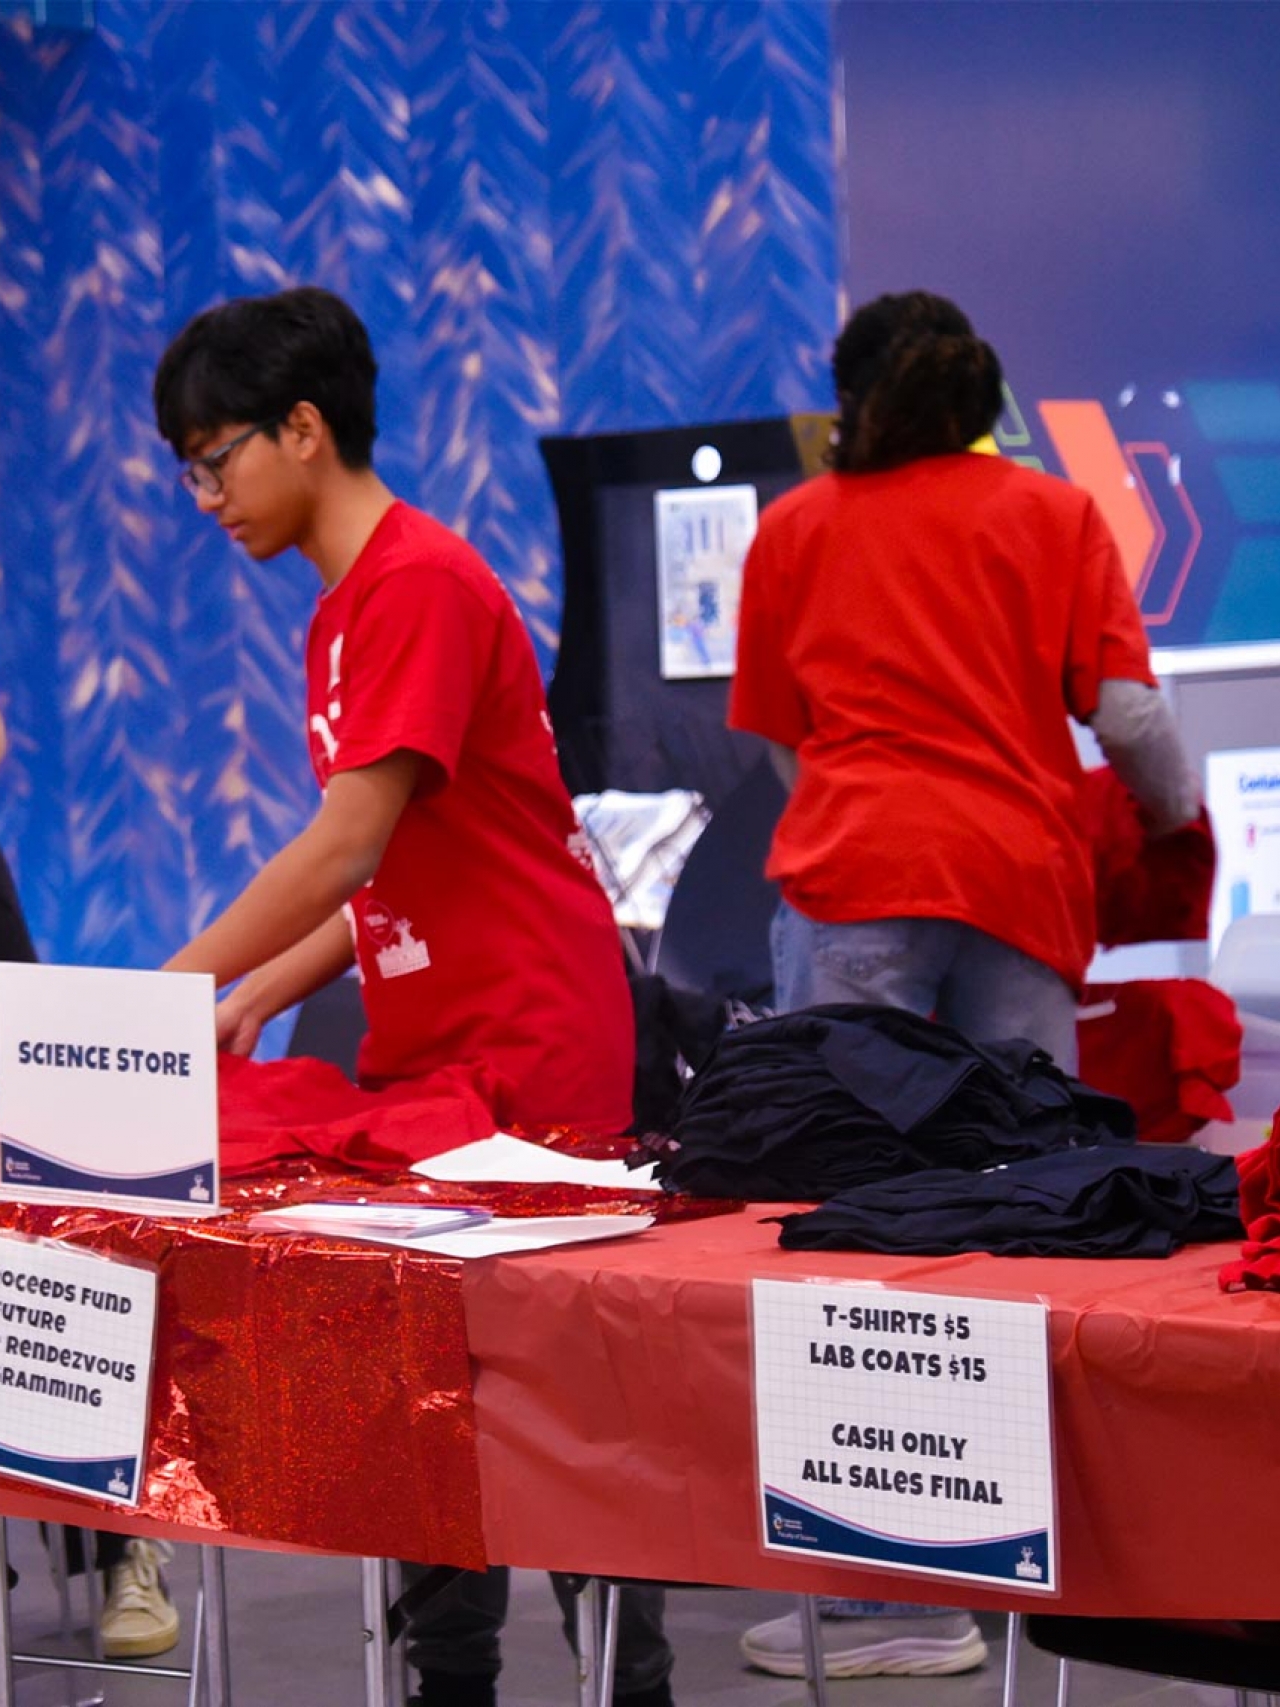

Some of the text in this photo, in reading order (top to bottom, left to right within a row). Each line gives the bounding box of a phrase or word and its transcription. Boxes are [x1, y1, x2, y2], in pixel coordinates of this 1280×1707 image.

[18, 1040, 191, 1077] SCIENCE STORE
[80, 1287, 132, 1315] FUND
[822, 1304, 970, 1340] T-SHIRTS $5
[5, 1335, 136, 1382] RENDEZVOUS
[810, 1341, 987, 1383] LAB COATS $15
[831, 1423, 968, 1461] CASH ONLY
[801, 1458, 1003, 1505] ALL SALES FINAL
